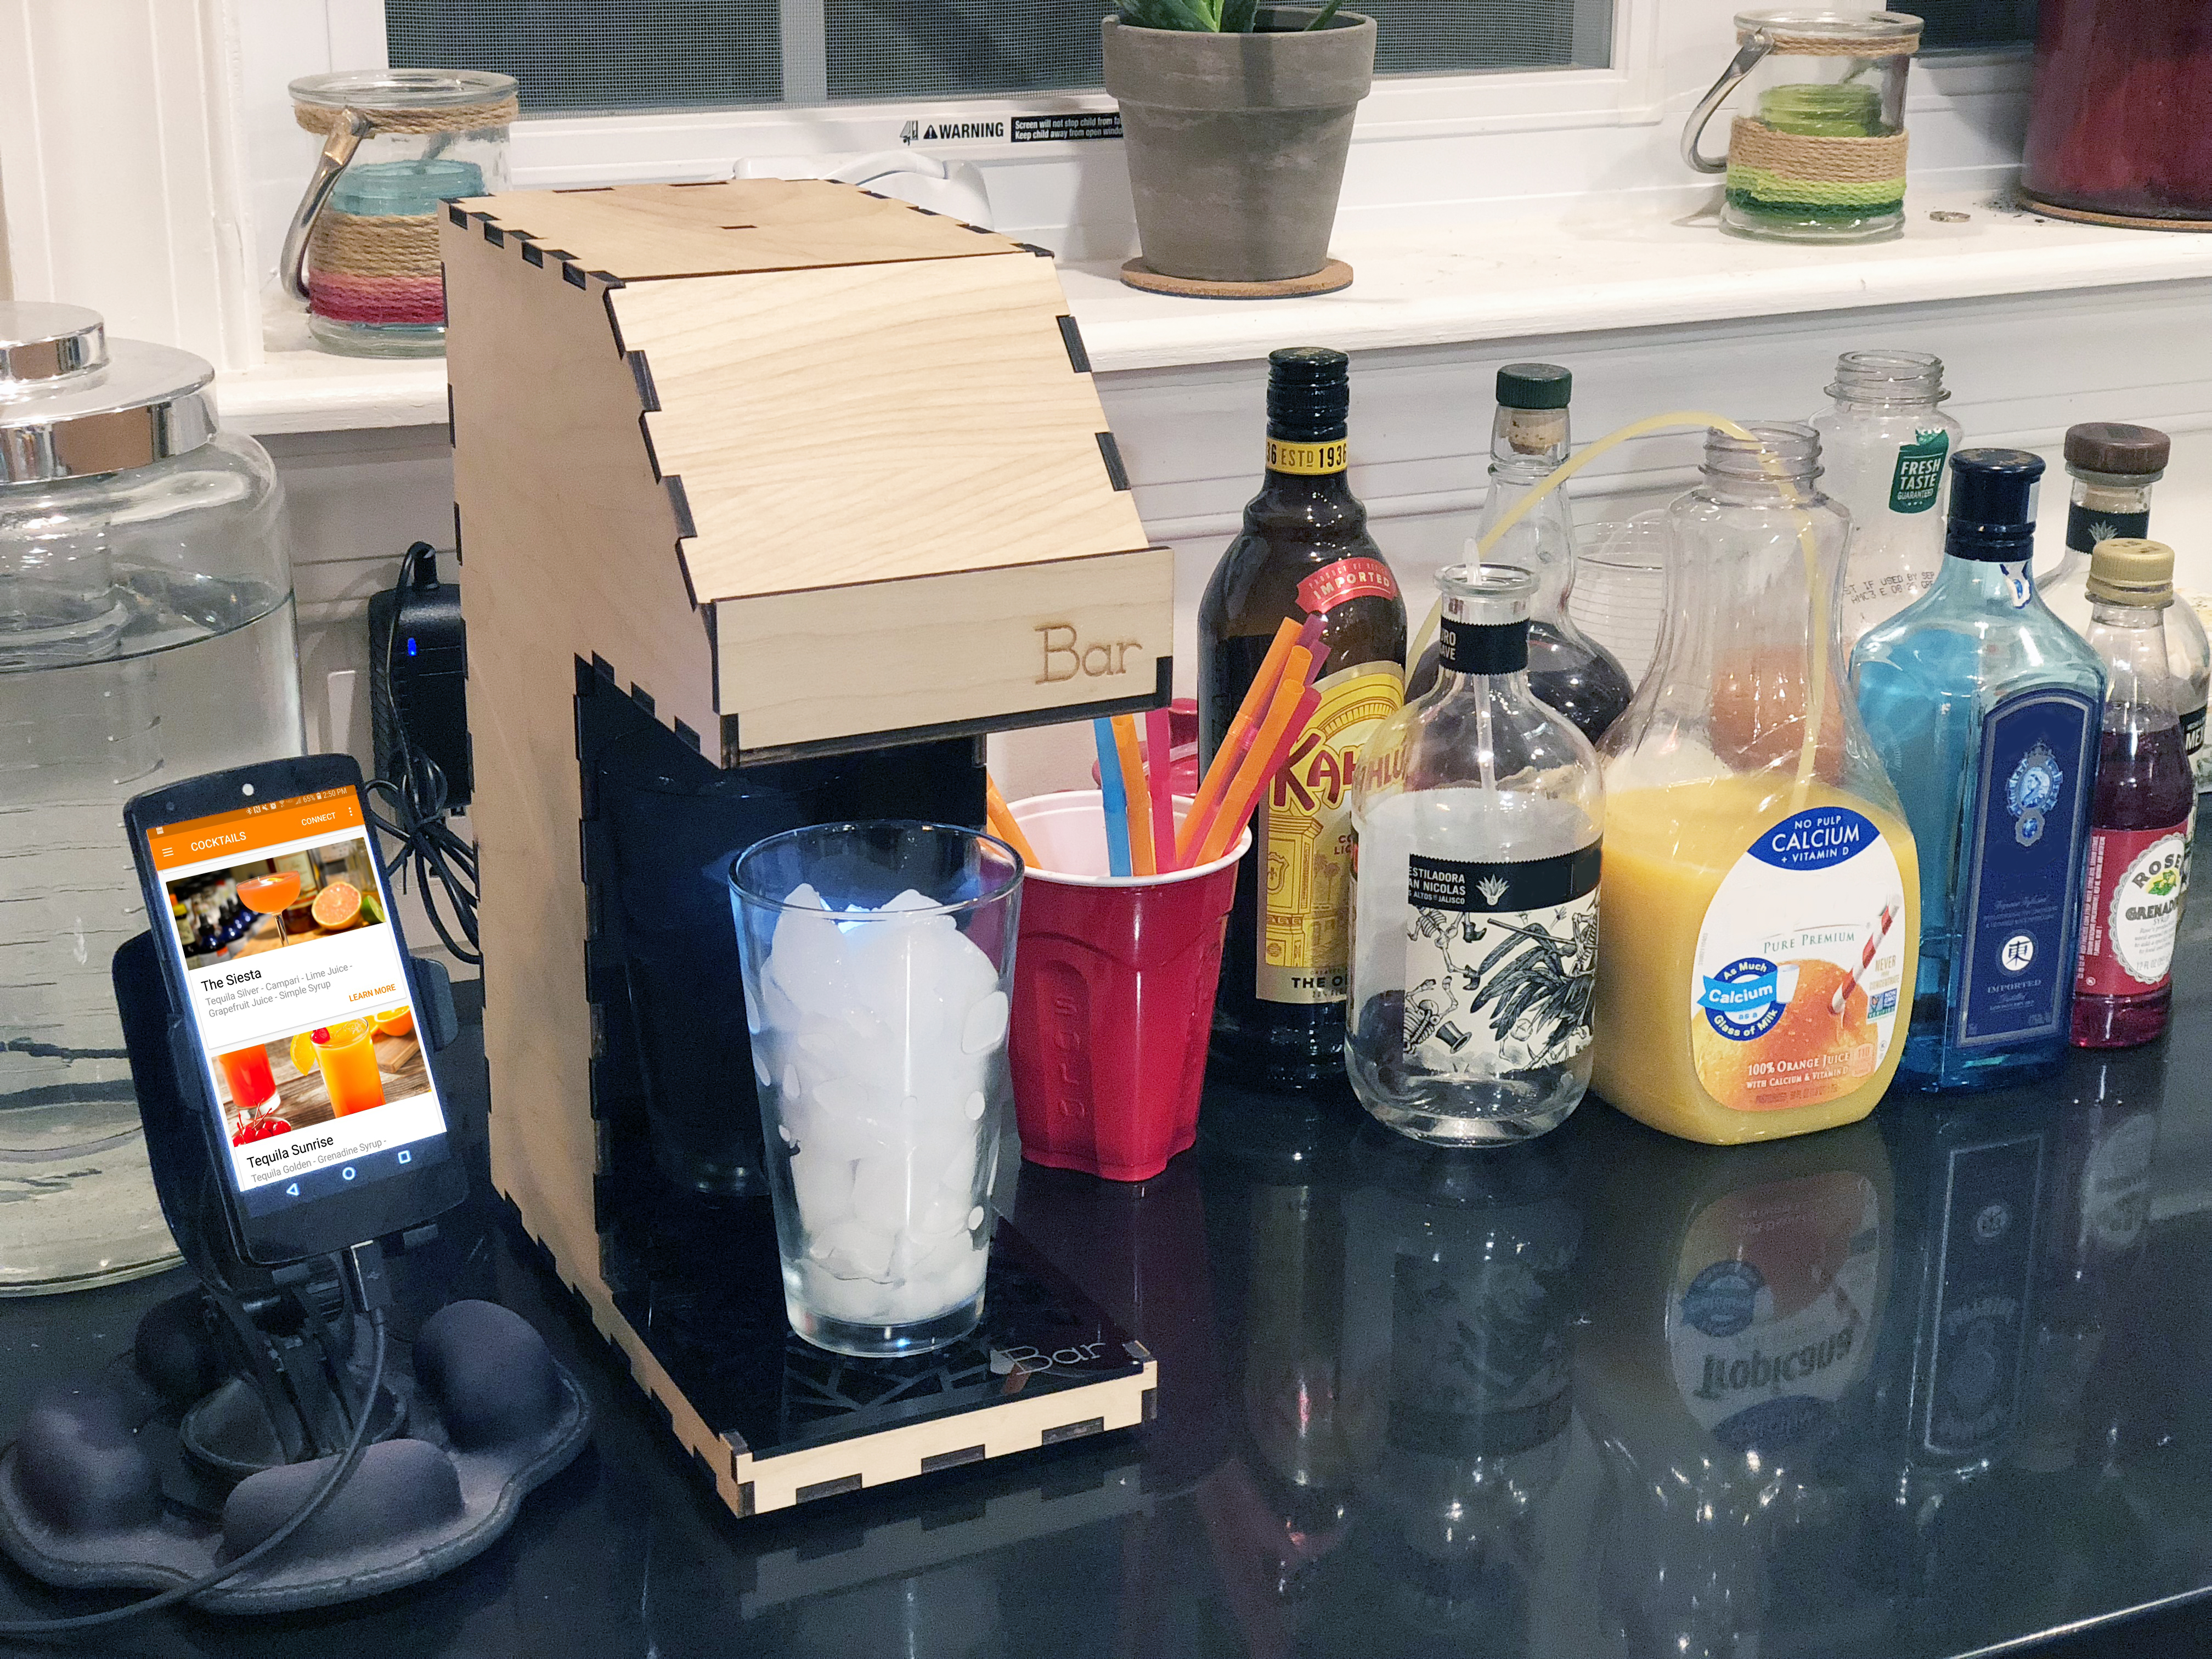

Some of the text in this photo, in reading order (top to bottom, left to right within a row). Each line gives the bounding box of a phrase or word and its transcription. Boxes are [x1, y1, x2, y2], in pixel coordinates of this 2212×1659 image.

[939, 122, 1004, 139] WARNING
[1015, 120, 1037, 129] Screen
[1039, 119, 1051, 128] will
[1064, 119, 1079, 128] stop
[1080, 118, 1096, 126] child
[1098, 117, 1112, 125] from
[1015, 127, 1123, 140] Keep child away from open windo
[1282, 448, 1314, 467] ESTD
[1319, 443, 1347, 469] 1936
[1901, 458, 1941, 475] FRESH
[1900, 473, 1937, 490] TASTE
[1898, 488, 1934, 500] GUARANTEED
[1313, 572, 1390, 600] IMPORTED
[1863, 580, 1874, 590] IF
[1881, 575, 1904, 585] USED
[1907, 573, 1917, 581] BY
[1441, 628, 1457, 646] URO
[1033, 623, 1142, 685] Bar
[1440, 644, 1457, 661] AVE
[303, 793, 315, 803] 65%
[323, 790, 336, 799] 2:50
[191, 812, 336, 851] COCKTAILS CONNECT
[1795, 815, 1841, 830] NO PULP
[1772, 823, 1859, 852] CALCIUM
[1792, 848, 1837, 862] VITAMIN
[1843, 847, 1849, 856] D
[1409, 867, 1465, 884] ESTILADORA
[1409, 878, 1420, 889] AN
[1423, 881, 1466, 895] NICOLAS
[1413, 891, 1432, 901] ALTOS
[1438, 895, 1465, 905] JALISCO
[1764, 933, 1854, 954] PURE PREMIUM
[1724, 962, 1767, 980] As Much
[1876, 955, 1896, 972] NEVER
[201, 969, 262, 992] The Siesta
[205, 992, 236, 1007] Tequila
[237, 988, 259, 1002] Silver
[266, 978, 300, 994] Campari
[306, 969, 326, 982] Lime
[328, 964, 348, 977] Juice
[1291, 977, 1325, 989] THE
[1988, 979, 2042, 994] IMPORTED
[208, 1002, 250, 1018] Grapefruit
[251, 996, 273, 1008] Juice
[279, 986, 307, 1002] Simple
[309, 980, 331, 995] Syrup
[349, 984, 396, 1002] LEARN MORE
[1709, 985, 1773, 1003] Calcium
[1714, 1009, 1778, 1036] Glass of Milk
[1748, 1052, 1850, 1076] 100% ORANGE JUICE
[1746, 1080, 1767, 1089] WITH
[1770, 1075, 1802, 1087] CALCIUM
[1813, 1070, 1841, 1080] VITAMIN
[247, 1136, 334, 1169] Tequila Sunrise
[251, 1169, 281, 1183] Tequila
[283, 1160, 312, 1173] Golden
[318, 1147, 358, 1165] Grenadine
[359, 1141, 382, 1155] Syrup
[997, 1341, 1106, 1375] Bar
